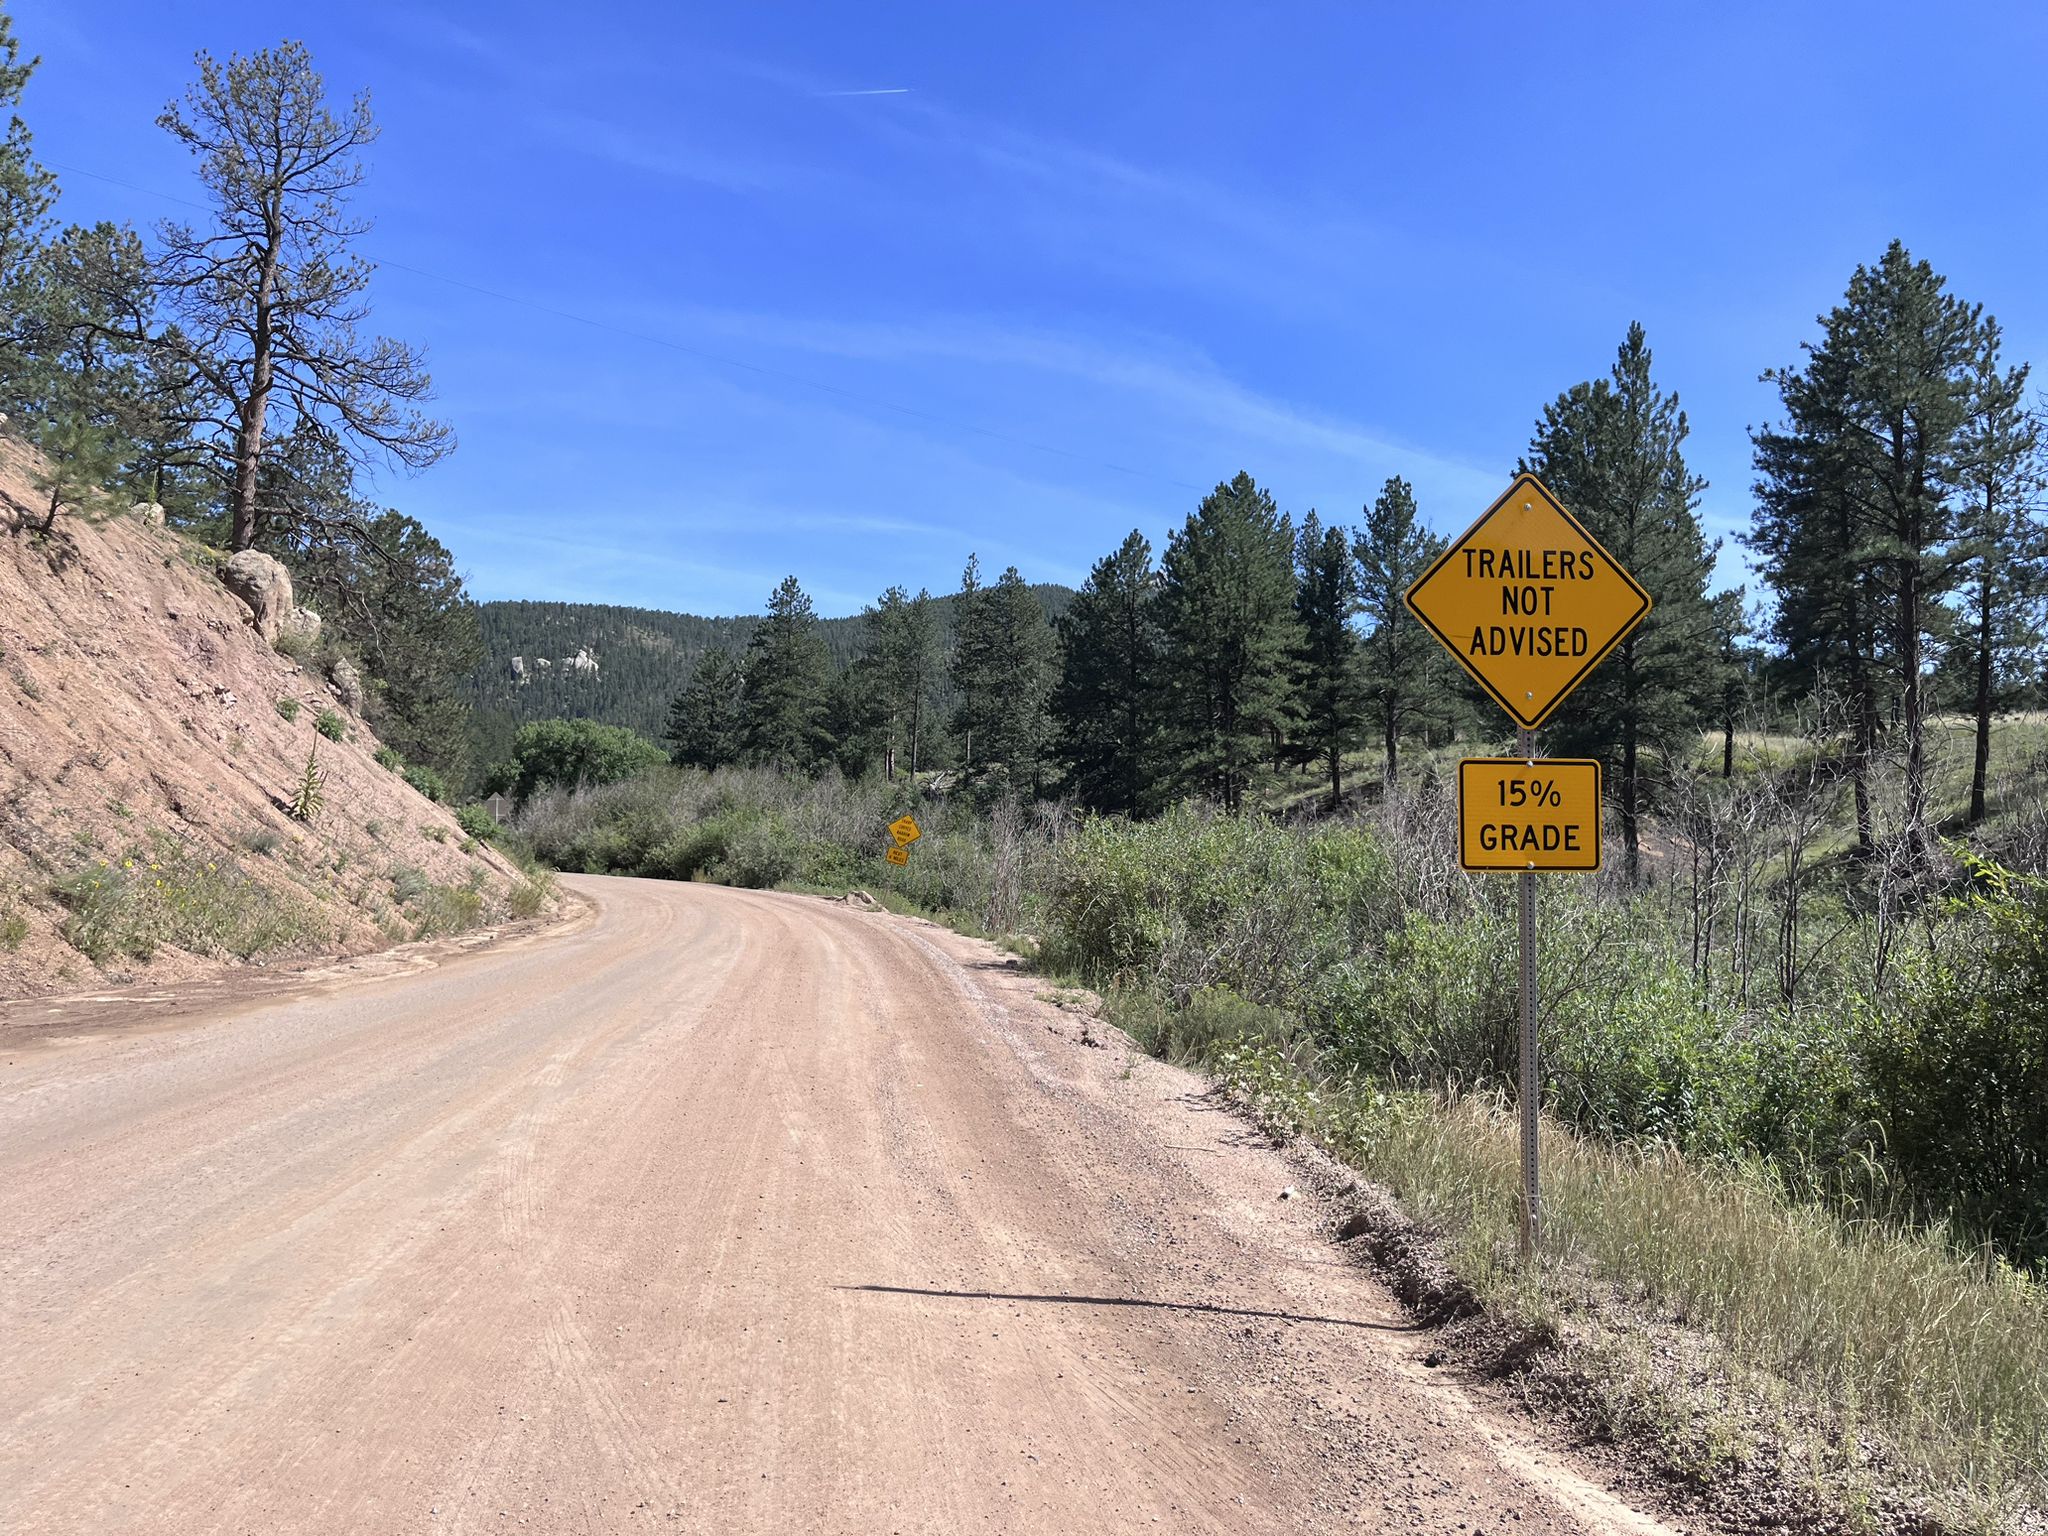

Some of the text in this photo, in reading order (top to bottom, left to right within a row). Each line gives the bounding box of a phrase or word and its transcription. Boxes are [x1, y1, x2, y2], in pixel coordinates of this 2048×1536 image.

[1462, 548, 1594, 580] TRAILERS
[1502, 585, 1555, 616] NOT
[1469, 625, 1588, 657] ADVISED
[1498, 780, 1562, 808] 15%
[1480, 824, 1581, 852] GRADE
